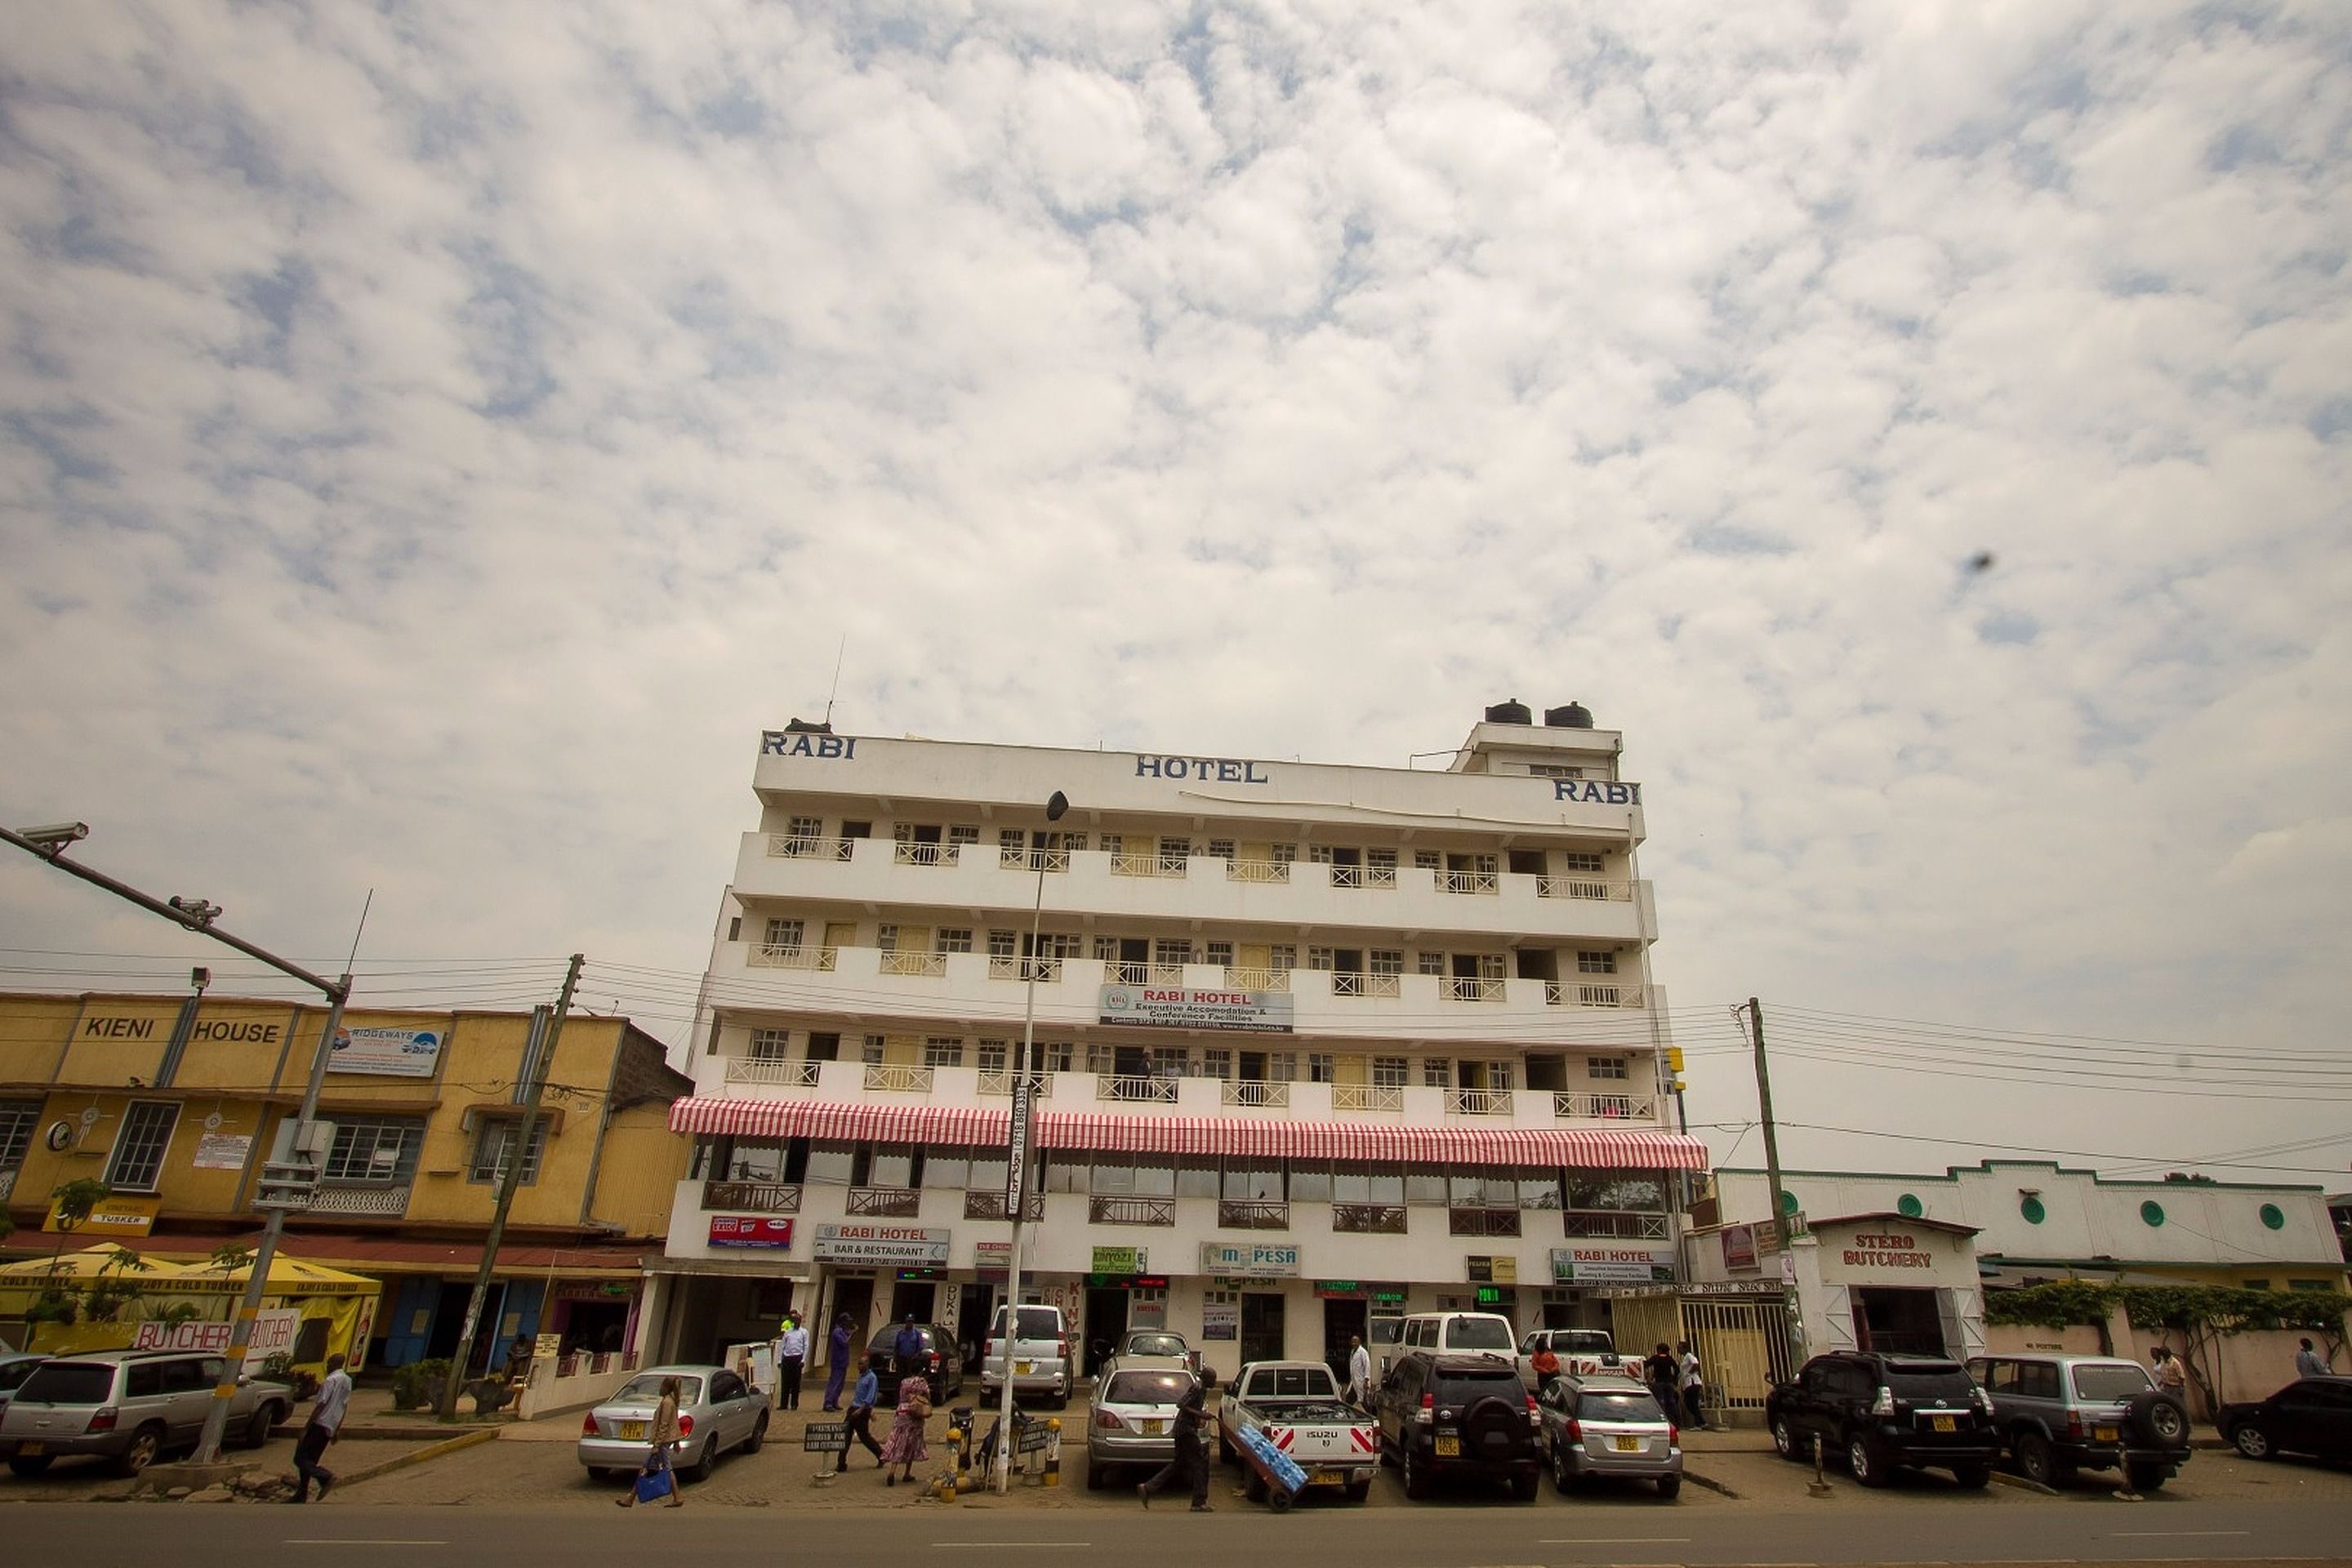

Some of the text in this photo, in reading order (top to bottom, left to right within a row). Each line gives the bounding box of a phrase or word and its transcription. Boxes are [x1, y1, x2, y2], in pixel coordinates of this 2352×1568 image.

[762, 733, 856, 760] RABI
[1136, 756, 1268, 784] HOTEL
[1552, 780, 1642, 805] RABI
[1143, 990, 1252, 1004] RABI HOTEL
[1136, 1003, 1183, 1011] Executive
[1187, 1005, 1256, 1014] Accomodation
[1149, 1011, 1252, 1022] Conference Facilities
[85, 1018, 279, 1043] KIENI HOUSE
[352, 1028, 414, 1040] RIDGEWAYS
[101, 1215, 141, 1223] TUSKER
[840, 1227, 928, 1240] RABI HOTEL
[835, 1245, 924, 1256] BAR & RESTAURANT
[1574, 1250, 1654, 1262] RABI HOTEL
[1843, 1250, 1931, 1267] BUTCHERY
